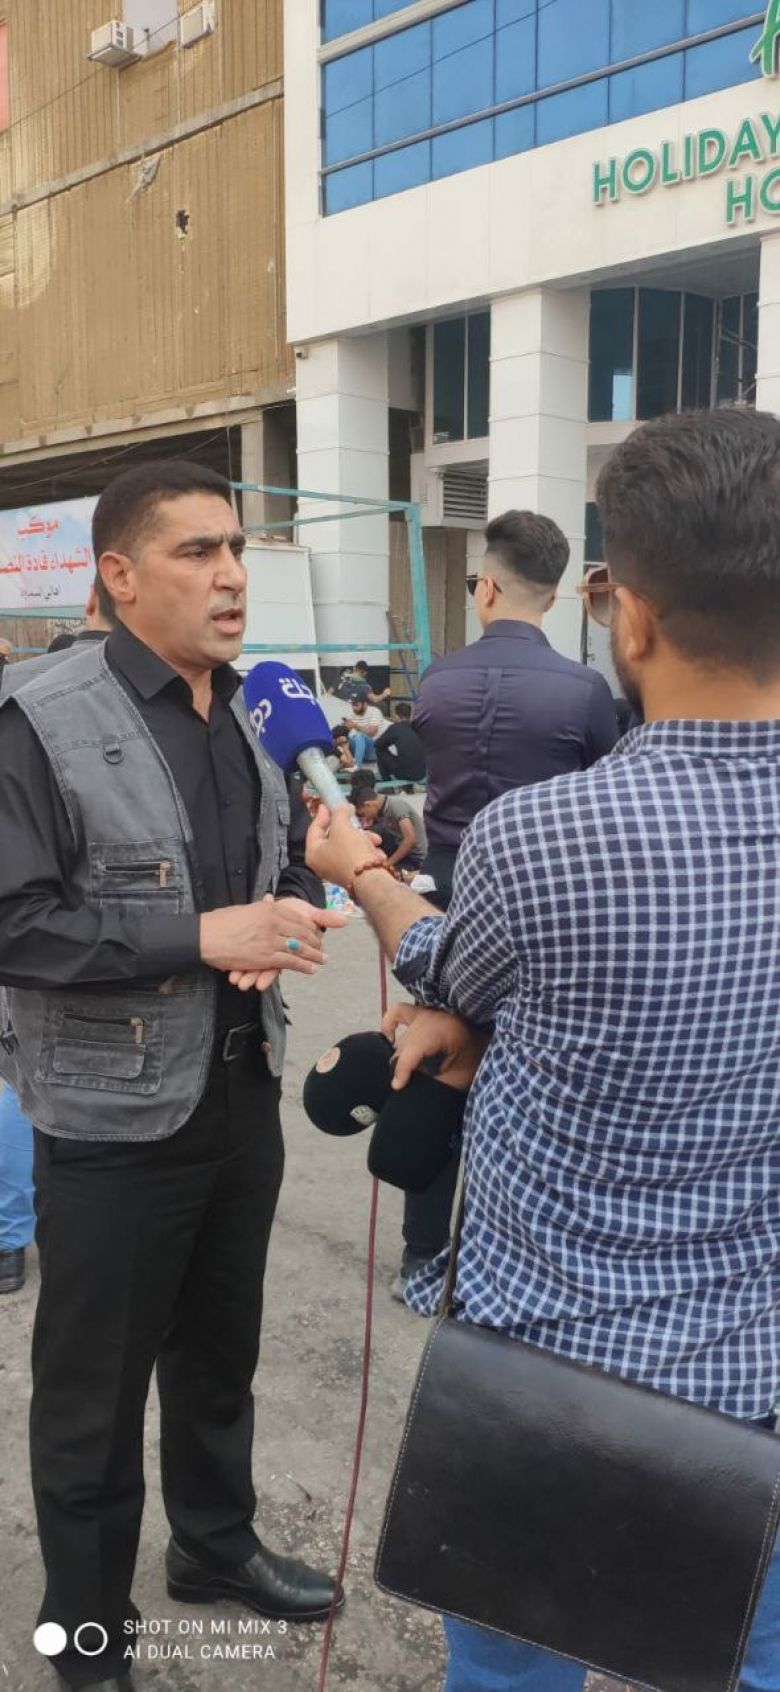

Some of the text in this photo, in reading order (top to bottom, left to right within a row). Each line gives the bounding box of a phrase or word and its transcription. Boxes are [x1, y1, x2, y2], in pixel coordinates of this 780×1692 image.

[592, 112, 780, 205] HOLIDAY
[17, 514, 59, 542] موكب
[279, 677, 316, 706] جلة
